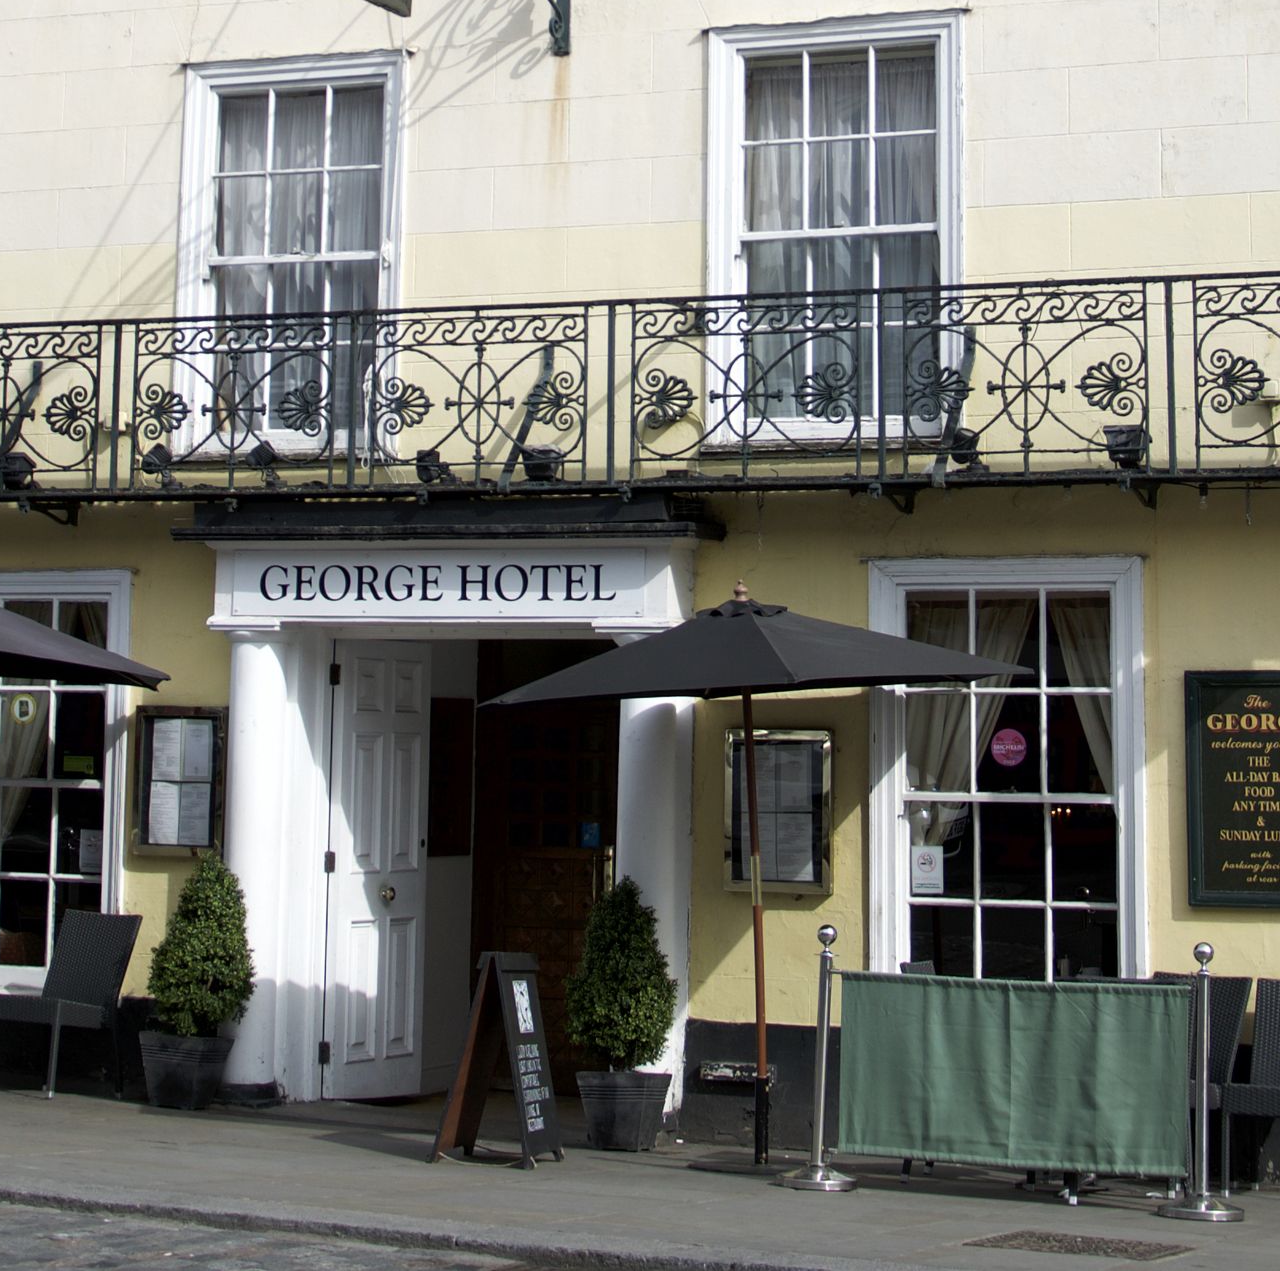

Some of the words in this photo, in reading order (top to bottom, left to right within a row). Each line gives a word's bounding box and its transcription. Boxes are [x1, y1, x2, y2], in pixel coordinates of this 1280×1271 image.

[259, 564, 444, 602] GEORGE
[456, 563, 617, 602] HOTEL
[1243, 694, 1272, 709] The
[1210, 737, 1263, 749] welcomes
[1247, 756, 1271, 767] THE
[1224, 771, 1269, 783] ALL-DAY
[1244, 786, 1275, 797] FOOD
[1232, 801, 1256, 812] ANY
[1256, 816, 1265, 827] &
[1220, 829, 1262, 841] SUNDAY
[1221, 860, 1260, 872] parking
